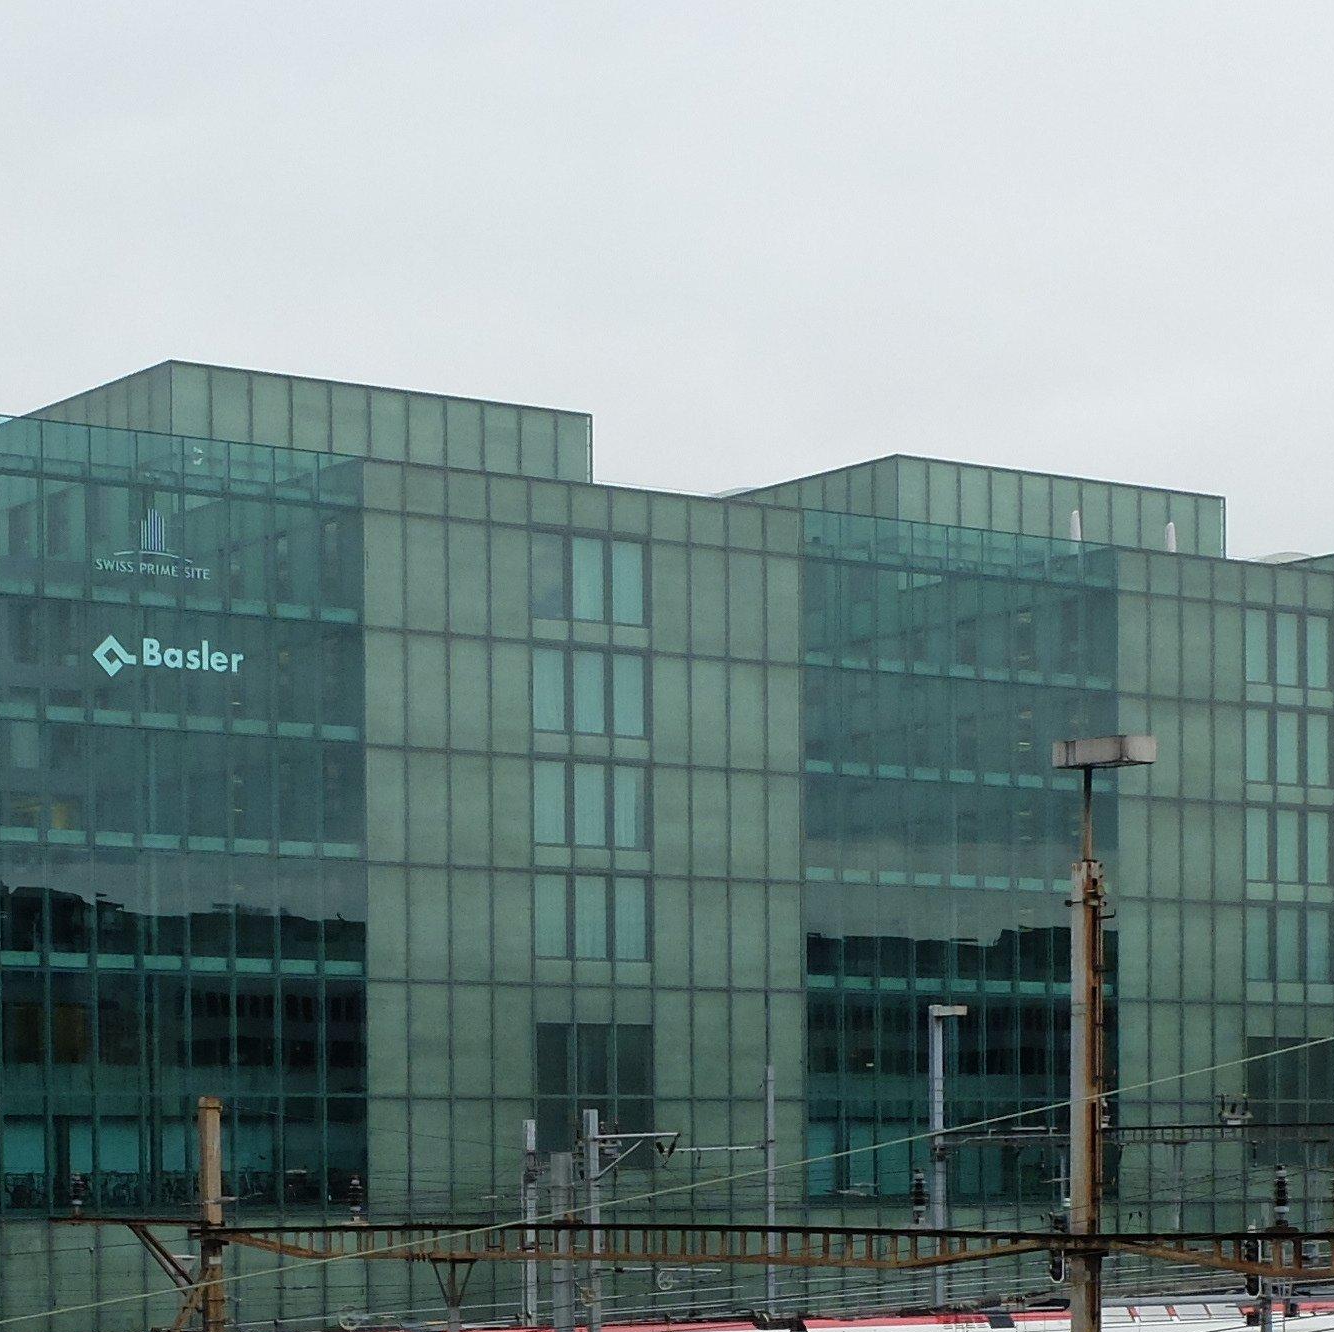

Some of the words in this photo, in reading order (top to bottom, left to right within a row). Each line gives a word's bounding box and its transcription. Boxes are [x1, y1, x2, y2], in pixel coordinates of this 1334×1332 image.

[95, 558, 134, 573] SWISS
[139, 562, 179, 577] PRIME
[184, 566, 211, 580] SITE
[142, 637, 244, 673] Basler
